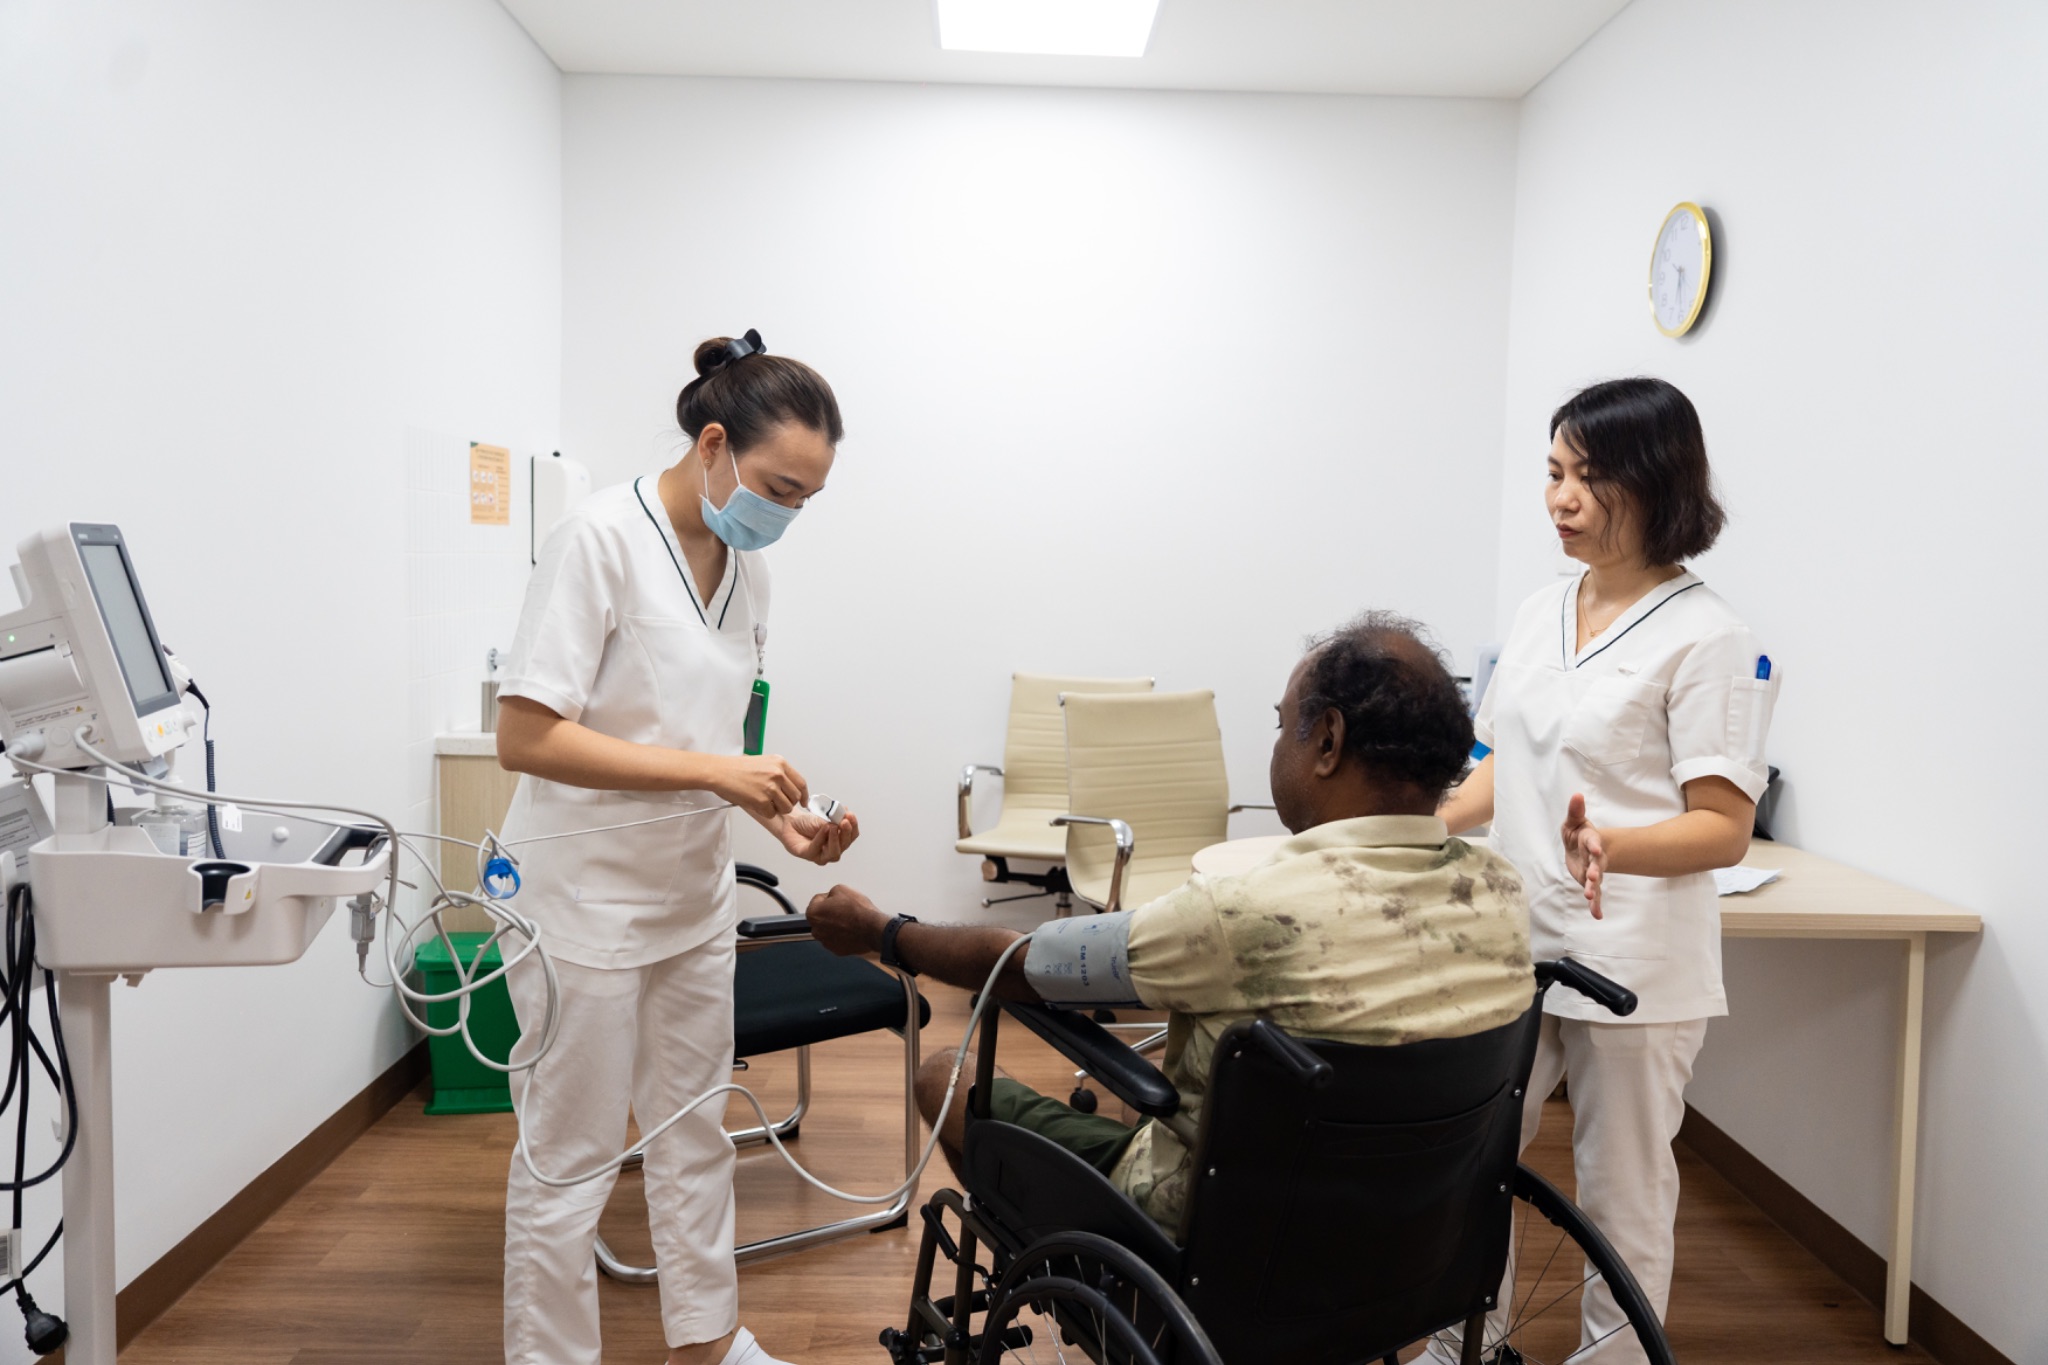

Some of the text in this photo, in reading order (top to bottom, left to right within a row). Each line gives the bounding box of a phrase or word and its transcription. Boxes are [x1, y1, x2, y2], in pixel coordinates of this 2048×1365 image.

[1680, 215, 1689, 230] 12
[1659, 272, 1666, 286] 9
[1661, 293, 1668, 308] 8
[1080, 945, 1090, 986] CM 1203
